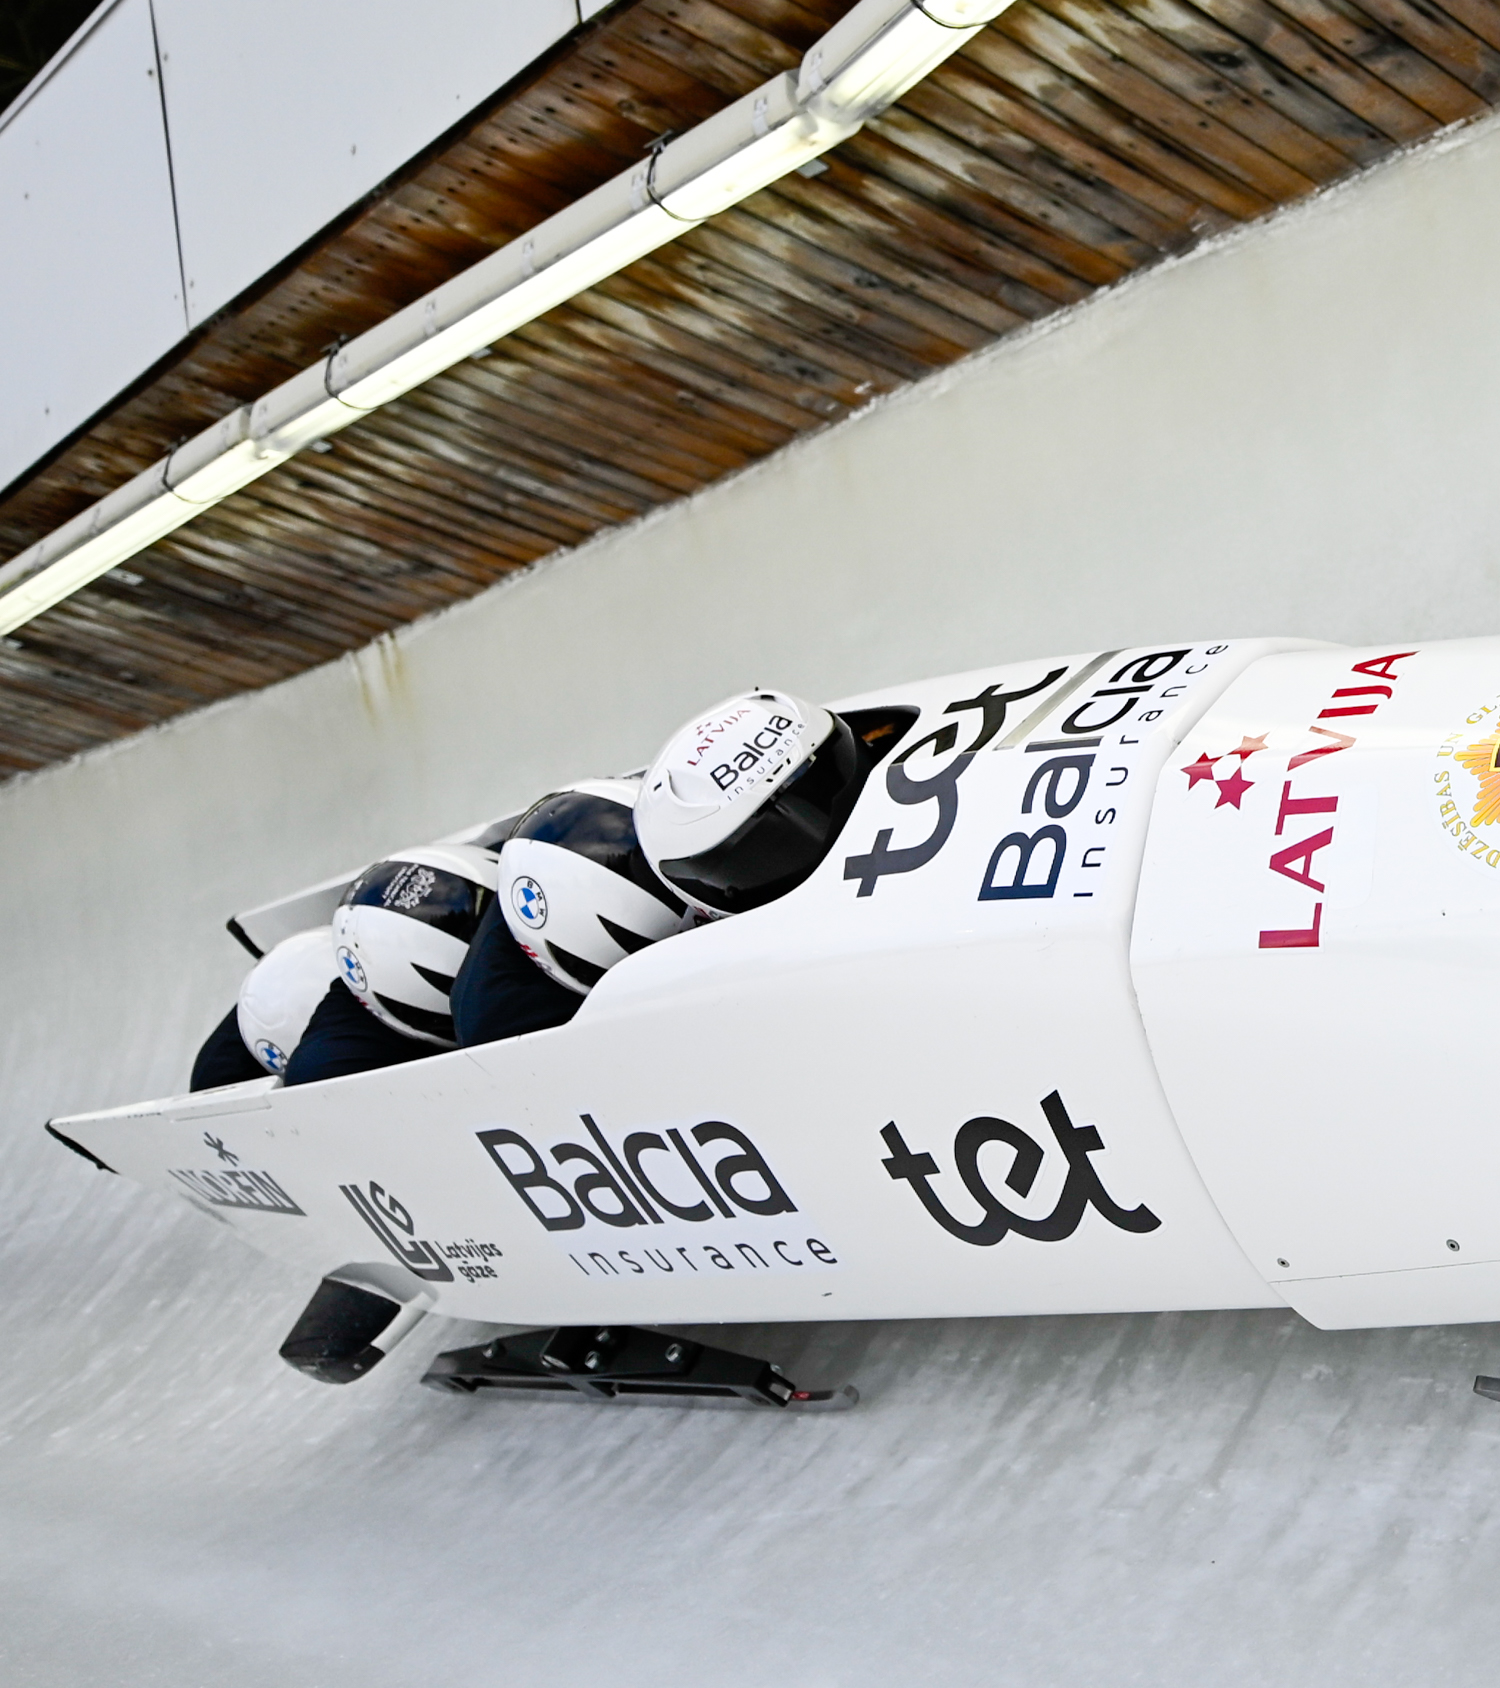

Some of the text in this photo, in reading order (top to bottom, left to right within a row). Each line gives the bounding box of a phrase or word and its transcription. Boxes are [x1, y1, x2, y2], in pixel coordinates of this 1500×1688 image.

[687, 709, 751, 766] LATVIJA
[709, 714, 793, 791] Balcia
[727, 723, 804, 801] insurance
[843, 666, 1069, 898] tet
[977, 648, 1193, 901] Balcia
[1073, 643, 1230, 898] insurance
[1436, 732, 1464, 758] UN
[1258, 650, 1421, 949] LATVIJA
[475, 1113, 799, 1232] Balcia
[879, 1088, 1163, 1247] tet
[435, 1238, 504, 1262] Latvijas
[569, 1236, 839, 1276] insurance
